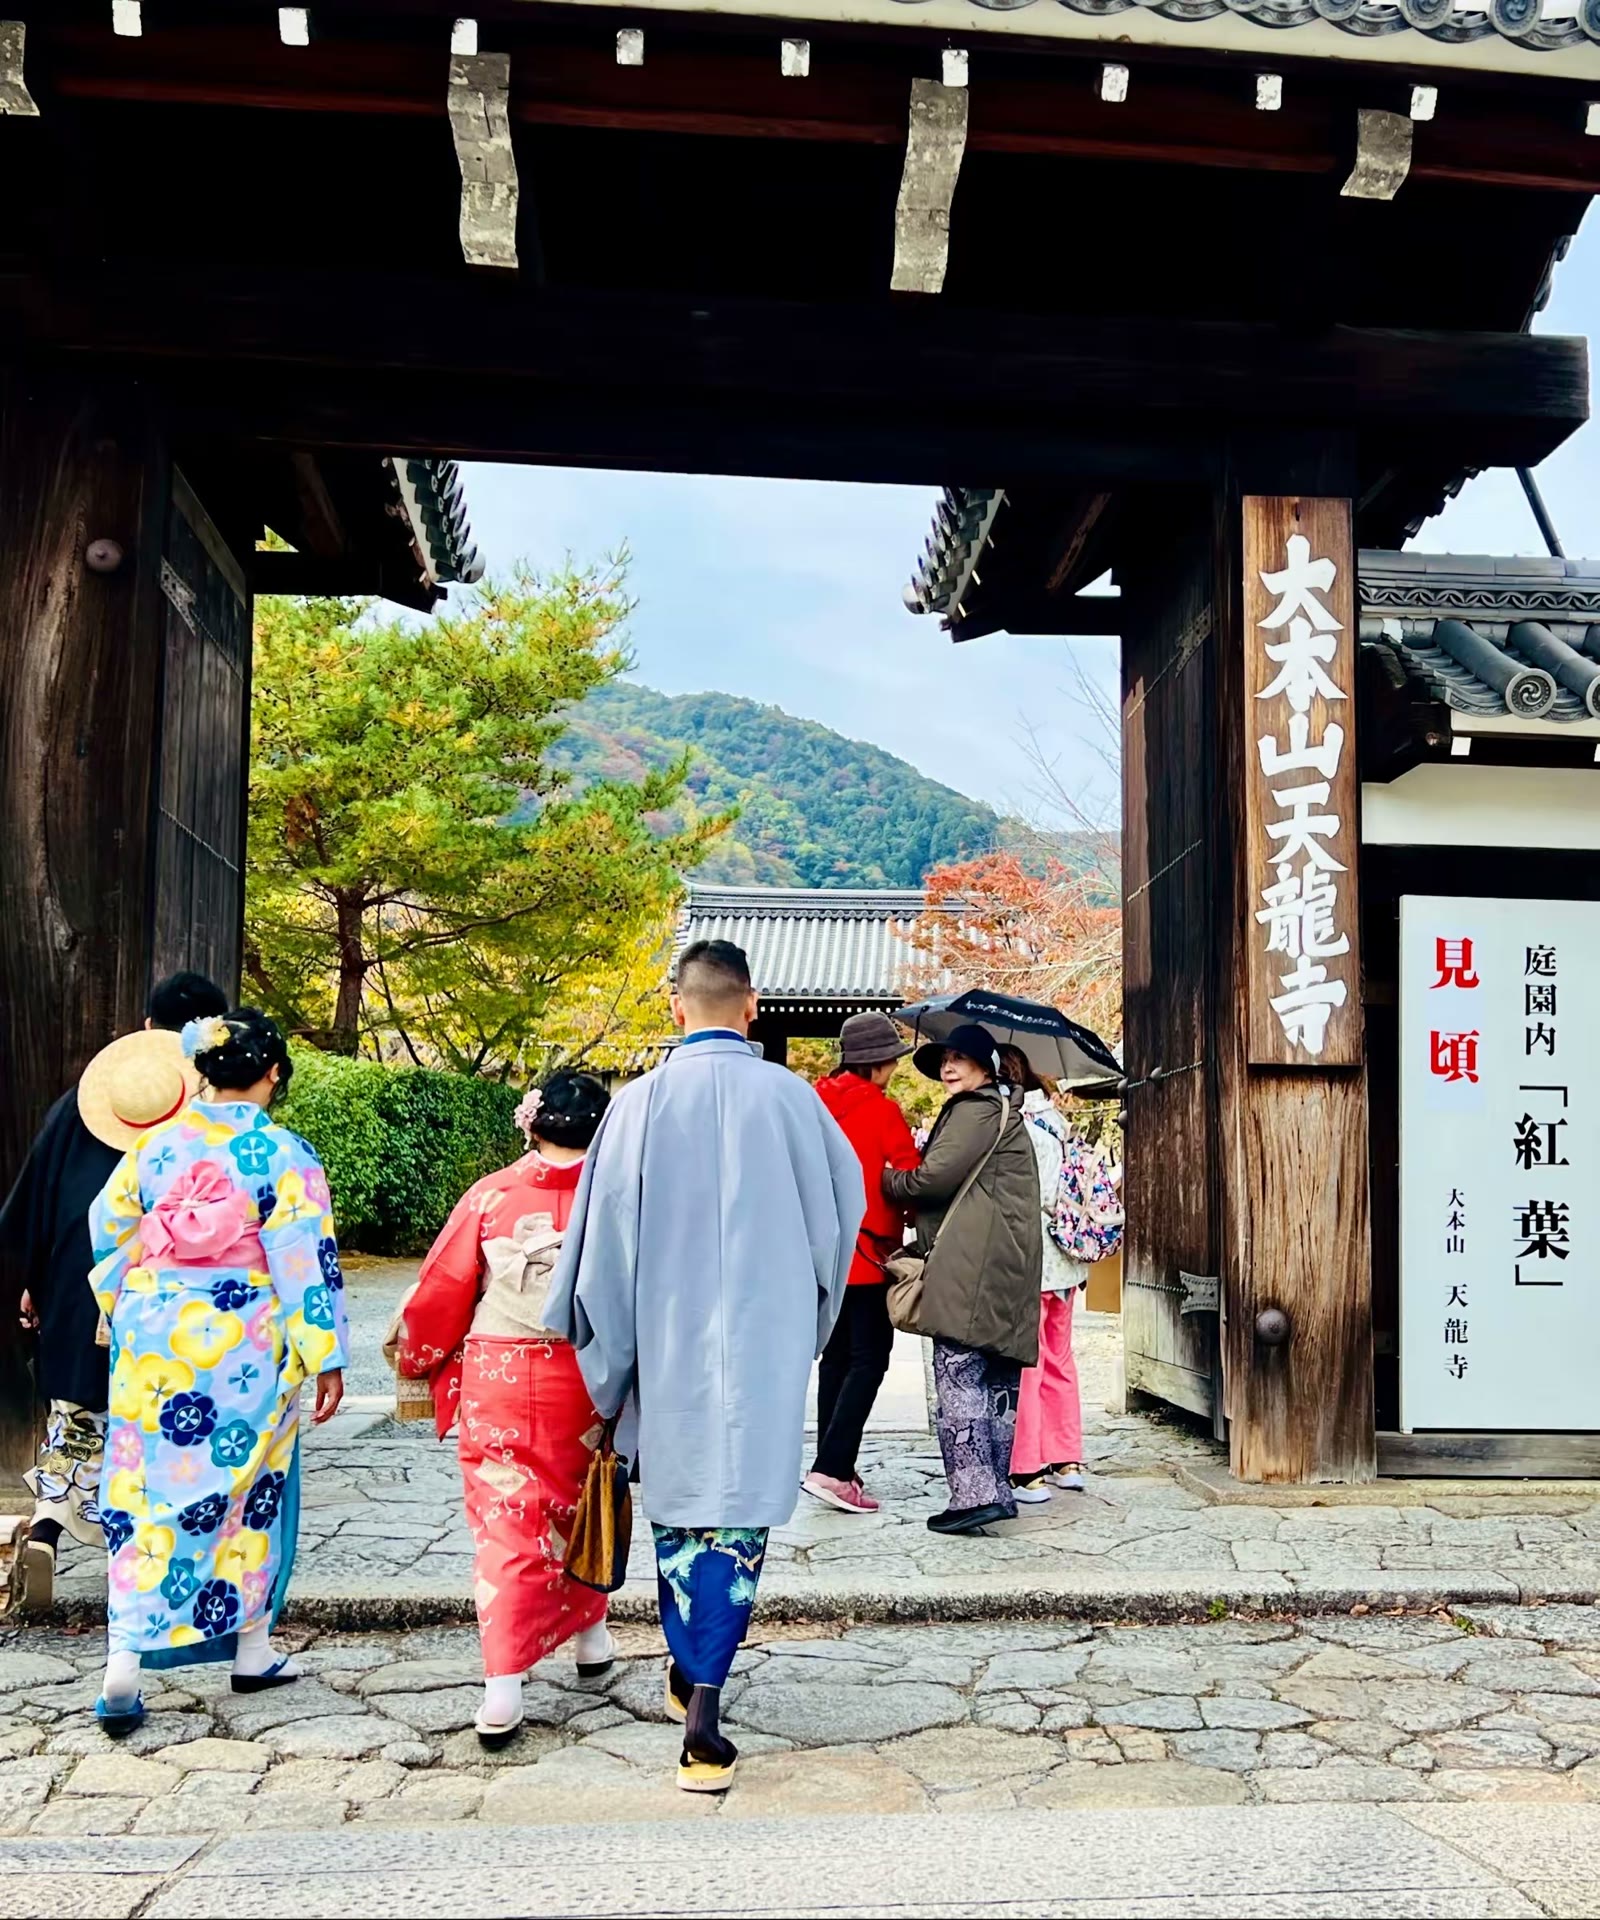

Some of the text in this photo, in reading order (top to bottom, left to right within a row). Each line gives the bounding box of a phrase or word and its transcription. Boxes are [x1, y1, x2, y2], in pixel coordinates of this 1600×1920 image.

[1254, 533, 1350, 1055] 大本山天龍寺
[1428, 936, 1481, 1084] 見頃
